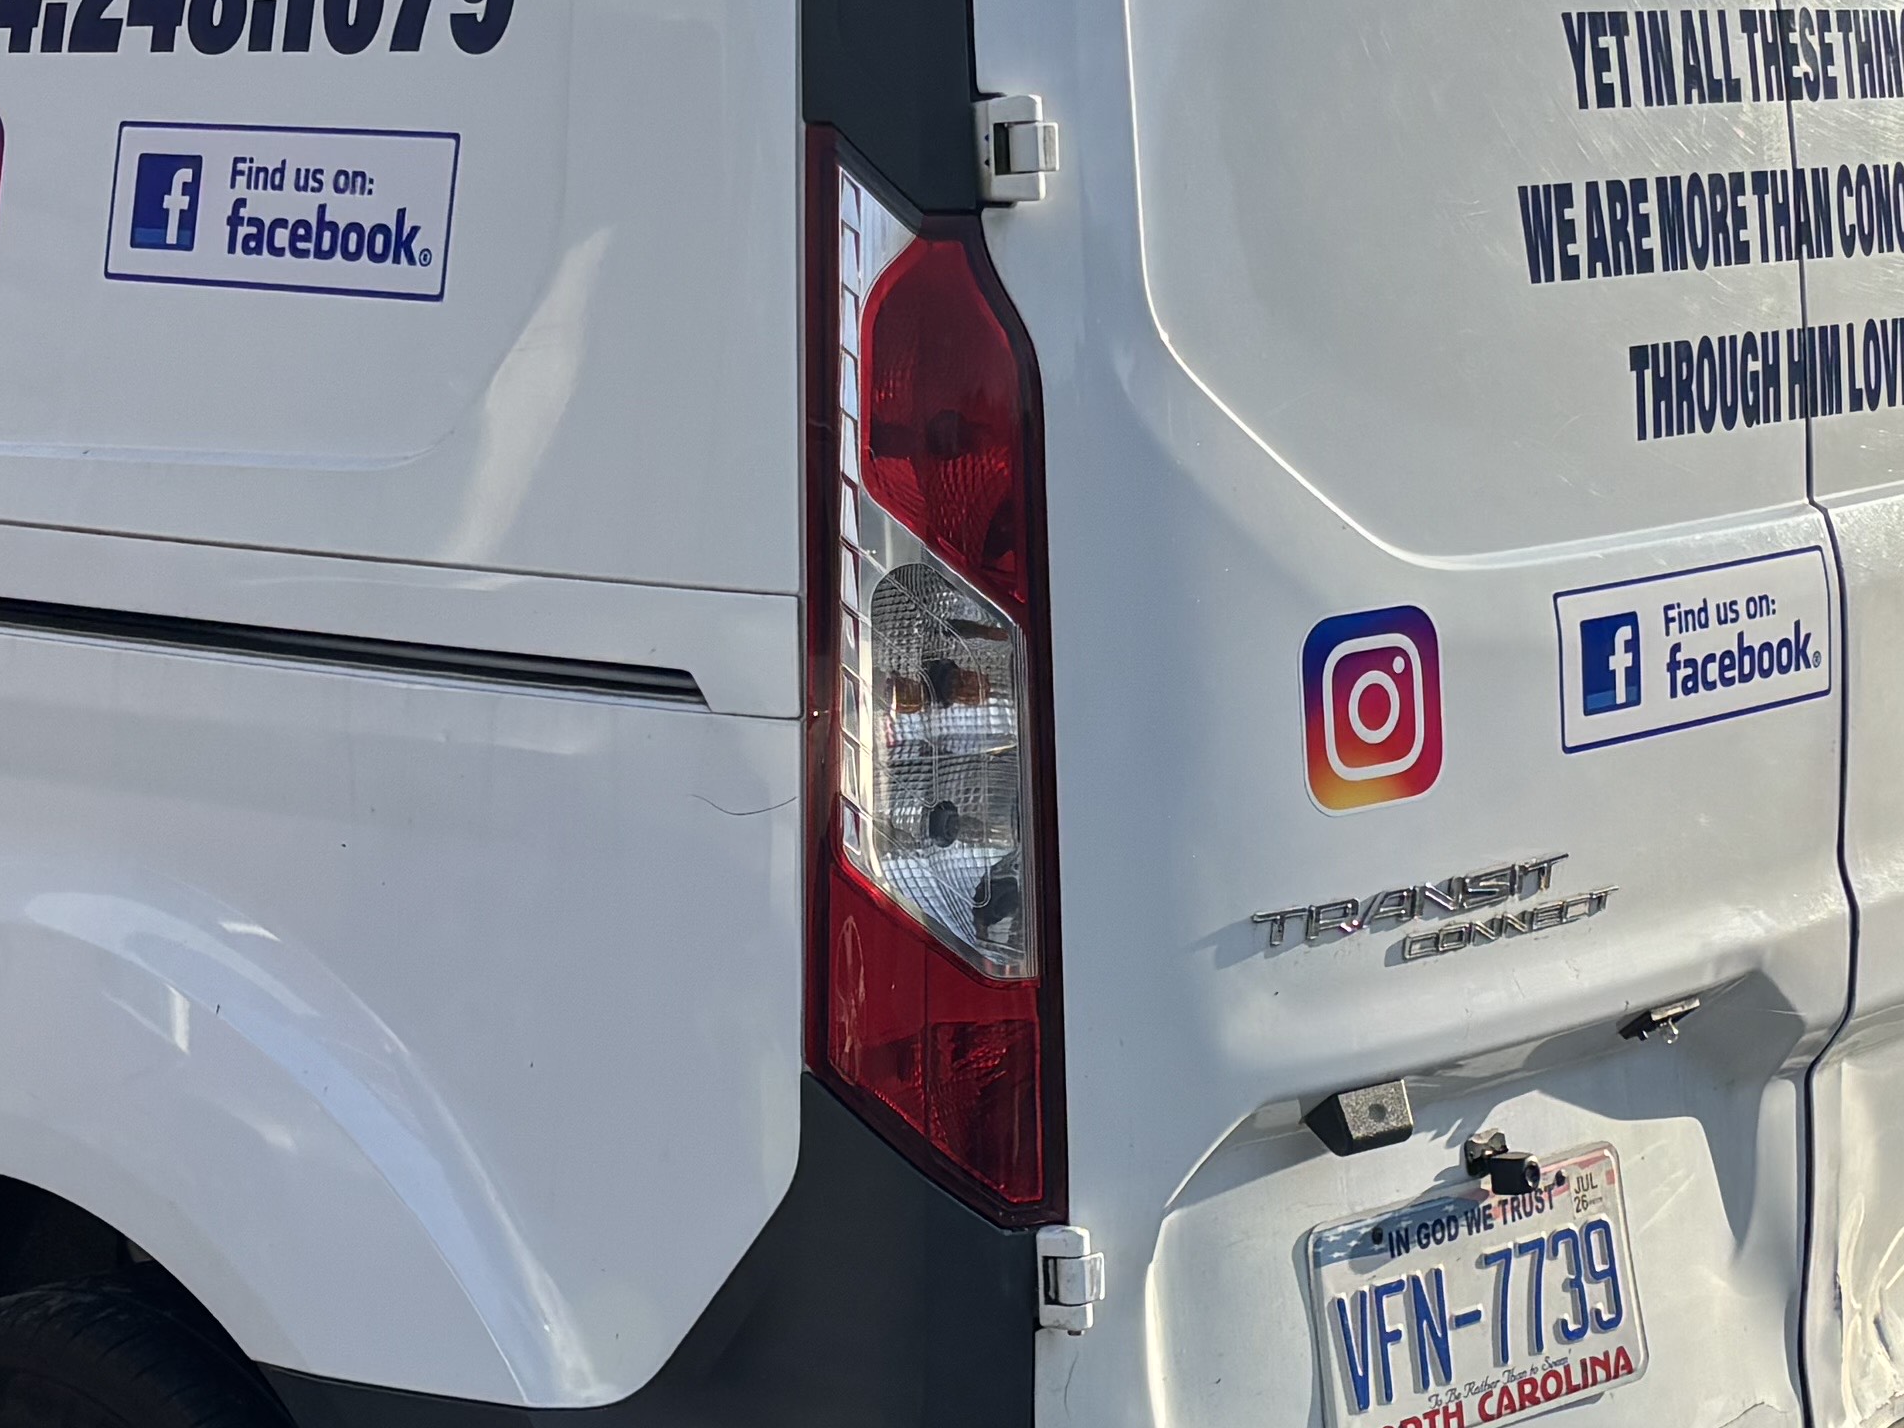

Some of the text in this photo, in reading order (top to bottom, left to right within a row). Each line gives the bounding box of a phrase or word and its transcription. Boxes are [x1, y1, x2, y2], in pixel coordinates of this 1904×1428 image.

[1562, 11, 1632, 110] YET
[1635, 11, 1677, 107] IN
[1683, 9, 1741, 105] ALL
[1740, 7, 1839, 102] THESE
[229, 156, 375, 196] Find us on:
[1518, 182, 1581, 284] WE
[1585, 176, 1654, 278] ARE
[1656, 171, 1751, 273] MORE
[1752, 165, 1834, 263] THAN
[1629, 329, 1783, 442] THROUGH
[1787, 324, 1843, 421] HIM
[1663, 593, 1777, 637] Find us on:
[1251, 852, 1569, 946] TRANSIT
[1404, 886, 1619, 960] CONNECT
[1388, 1183, 1556, 1259] IN GOD WE TRUST
[1573, 1173, 1599, 1195] JUL
[1573, 1194, 1589, 1213] 26
[1334, 1218, 1626, 1412] VFN-7739
[1477, 1345, 1635, 1422] CAROLINA
